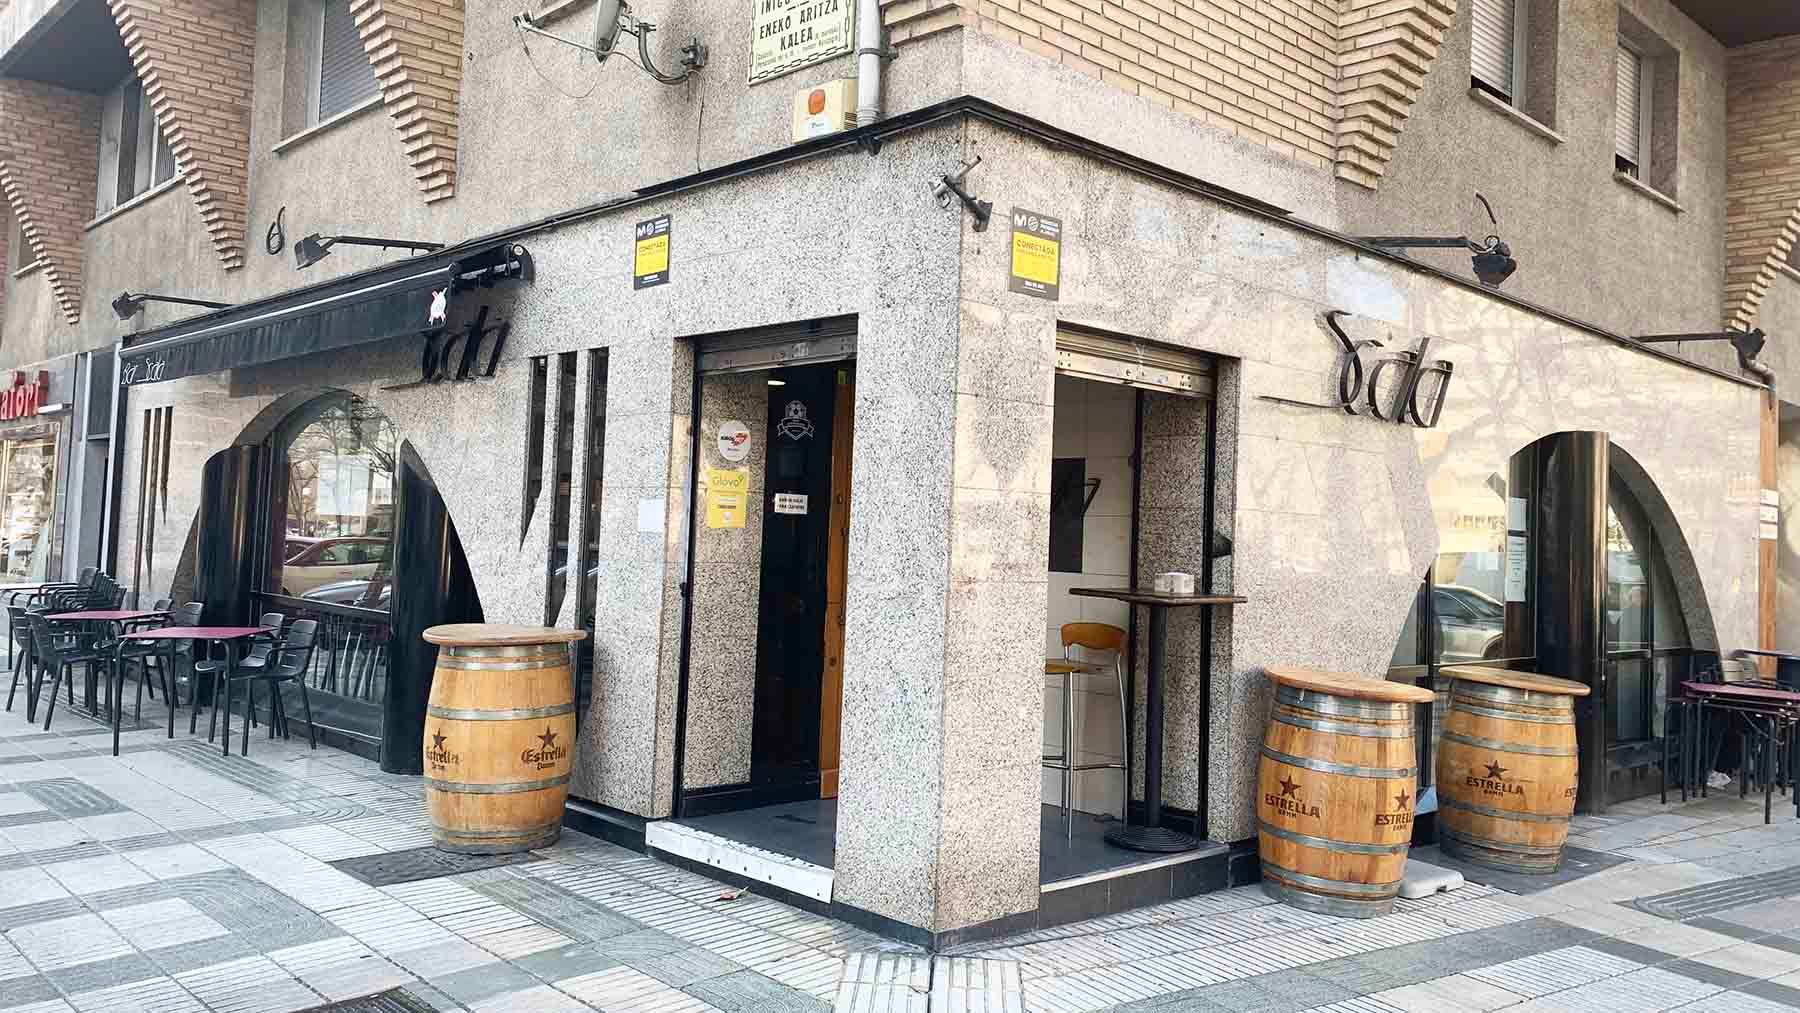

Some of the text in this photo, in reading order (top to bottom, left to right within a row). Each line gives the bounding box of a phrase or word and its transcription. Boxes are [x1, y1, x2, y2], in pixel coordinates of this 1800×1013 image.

[759, 15, 791, 40] ENEKO
[799, 0, 839, 24] ARITZA
[780, 26, 813, 51] KALEA
[521, 745, 567, 764] Estrella
[1465, 776, 1525, 795] ESTRELLA
[1264, 792, 1321, 818] ESTRELLA
